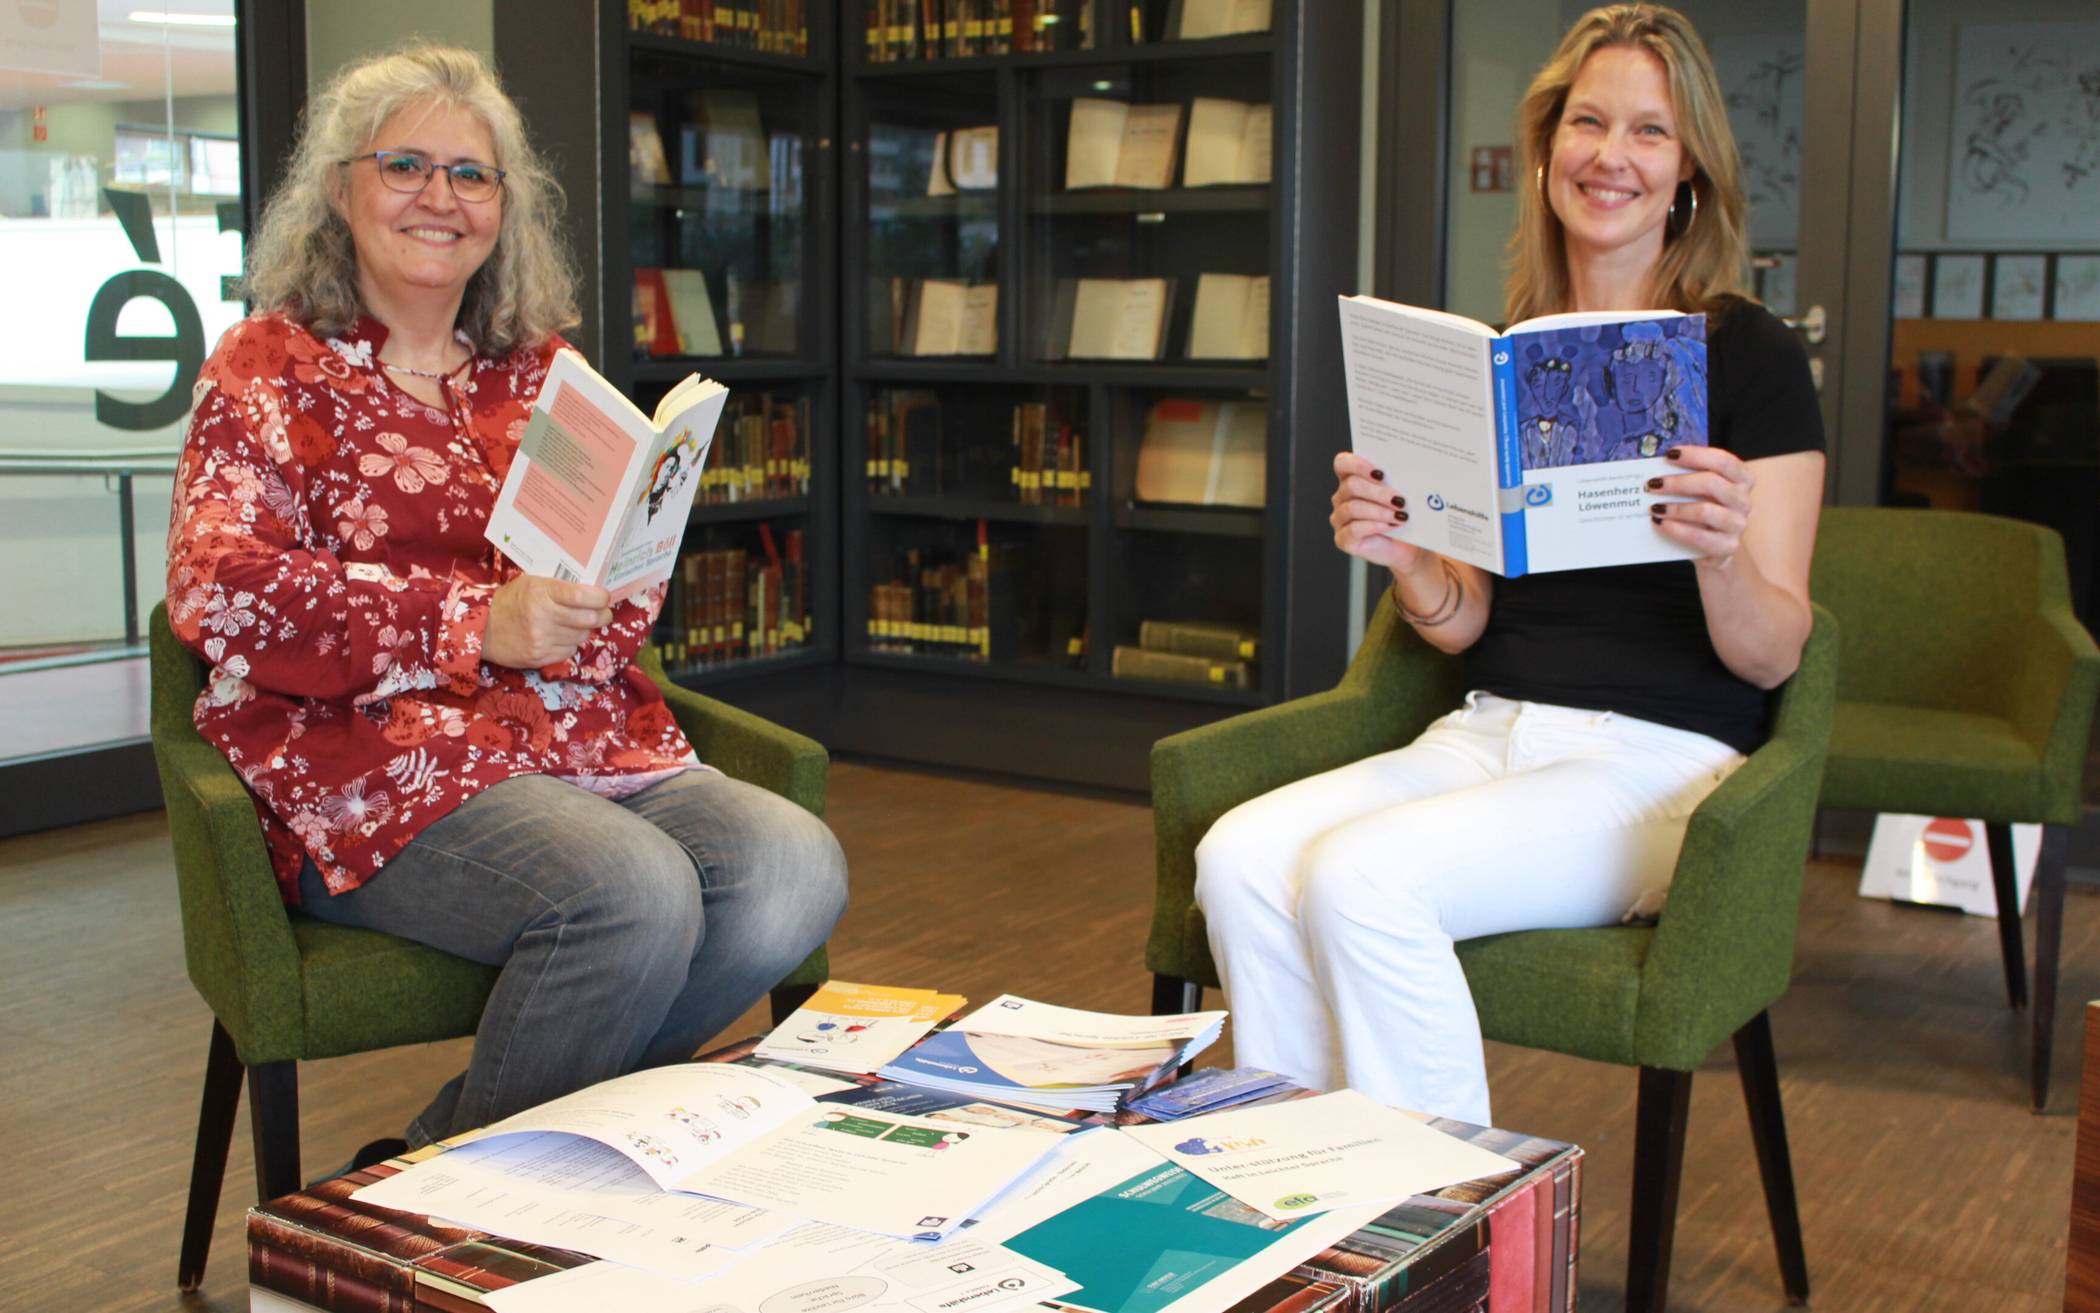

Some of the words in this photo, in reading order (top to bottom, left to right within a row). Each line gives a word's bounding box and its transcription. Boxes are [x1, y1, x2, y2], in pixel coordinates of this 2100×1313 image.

[1578, 486, 1640, 499] Hasenherz
[1578, 498, 1641, 512] Löwenmut
[1327, 1137, 1383, 1151] Familien
[1283, 1195, 1319, 1207] efa
[938, 1287, 1001, 1308] Lebenshilfe
